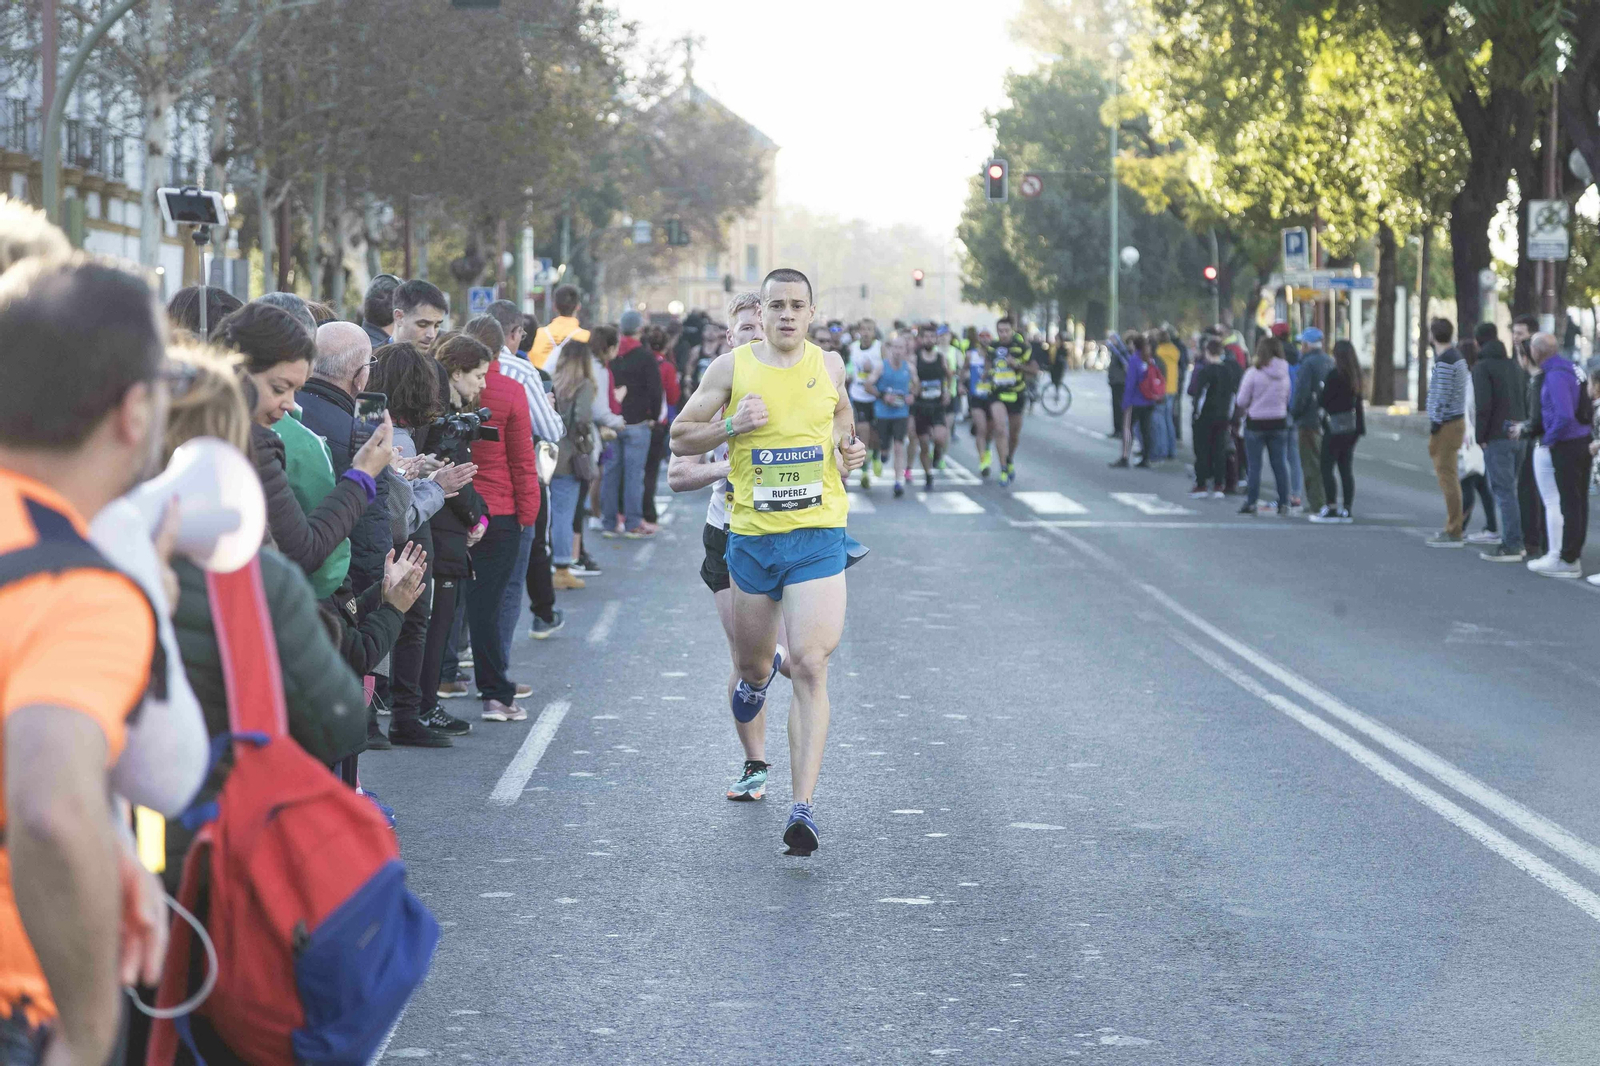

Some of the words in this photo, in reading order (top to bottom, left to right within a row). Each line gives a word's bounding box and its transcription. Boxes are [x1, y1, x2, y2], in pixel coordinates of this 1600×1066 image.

[1289, 234, 1301, 252] P
[776, 450, 816, 462] ZURICH
[779, 472, 800, 482] 778
[772, 488, 807, 498] RUPÉREZ
